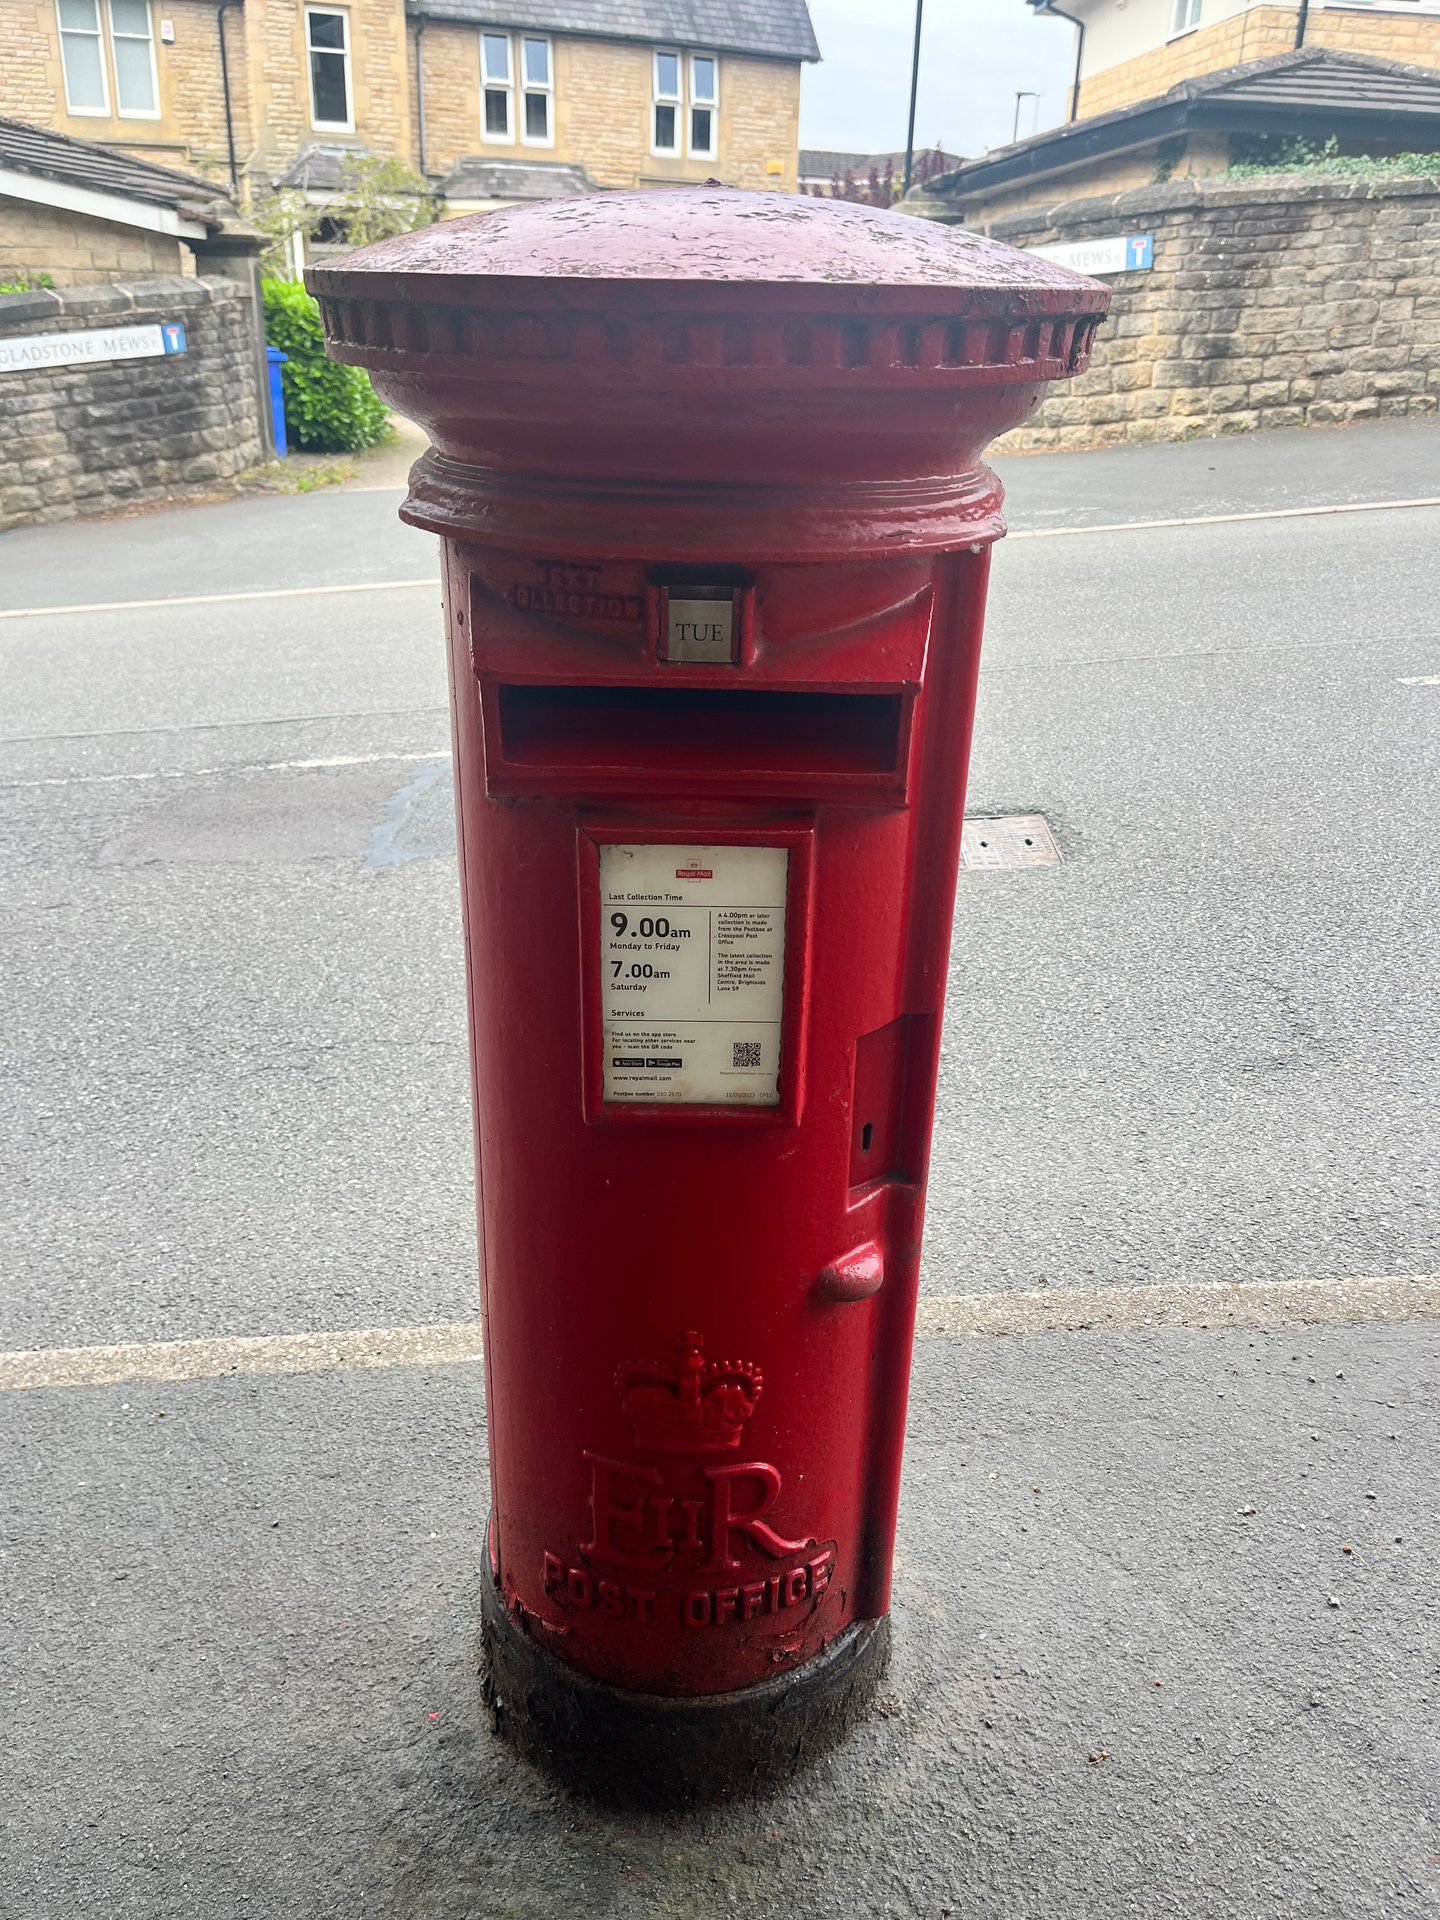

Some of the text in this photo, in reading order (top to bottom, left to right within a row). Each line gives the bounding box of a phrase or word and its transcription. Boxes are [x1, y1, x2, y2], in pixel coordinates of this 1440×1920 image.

[1070, 250, 1112, 267] MEWS
[0, 340, 94, 364] GLADSTONE
[104, 335, 149, 352] MEWS
[675, 623, 724, 642] TUE
[627, 893, 662, 901] Collection
[610, 912, 691, 938] 9.00am
[610, 943, 641, 951] Monday
[655, 943, 680, 951] Friday
[610, 960, 670, 979] 7.00am
[611, 983, 647, 992] Saturday
[611, 1009, 645, 1017] Services
[543, 1551, 833, 1628] POST OFFICE
